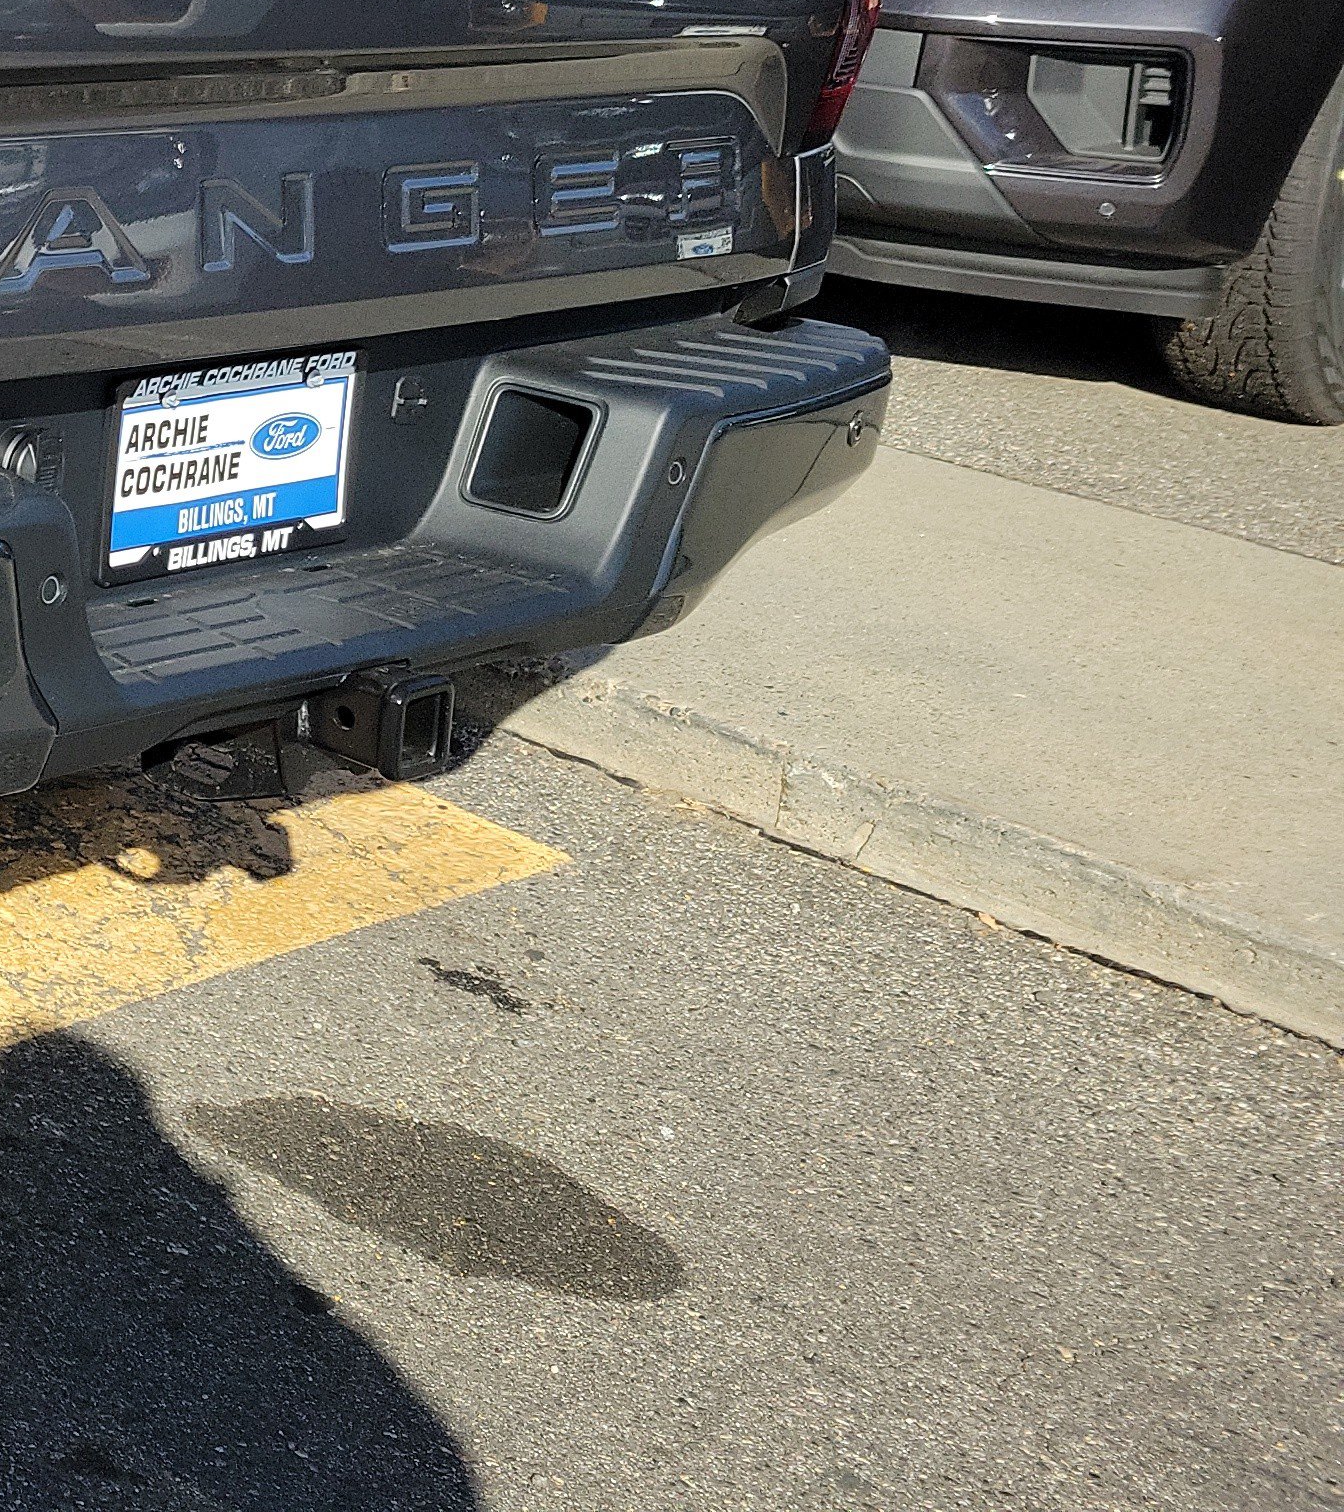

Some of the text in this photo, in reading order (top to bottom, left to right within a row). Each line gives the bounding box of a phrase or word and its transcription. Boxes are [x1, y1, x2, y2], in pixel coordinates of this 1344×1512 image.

[132, 351, 356, 398] ARCHIE COCHRANE FORD
[124, 414, 210, 455] ARCHIE
[262, 419, 307, 453] Ford
[120, 451, 242, 498] COCHRANE
[177, 492, 277, 534] BILLINGS, MT
[166, 526, 294, 571] BILLINGS, MT
